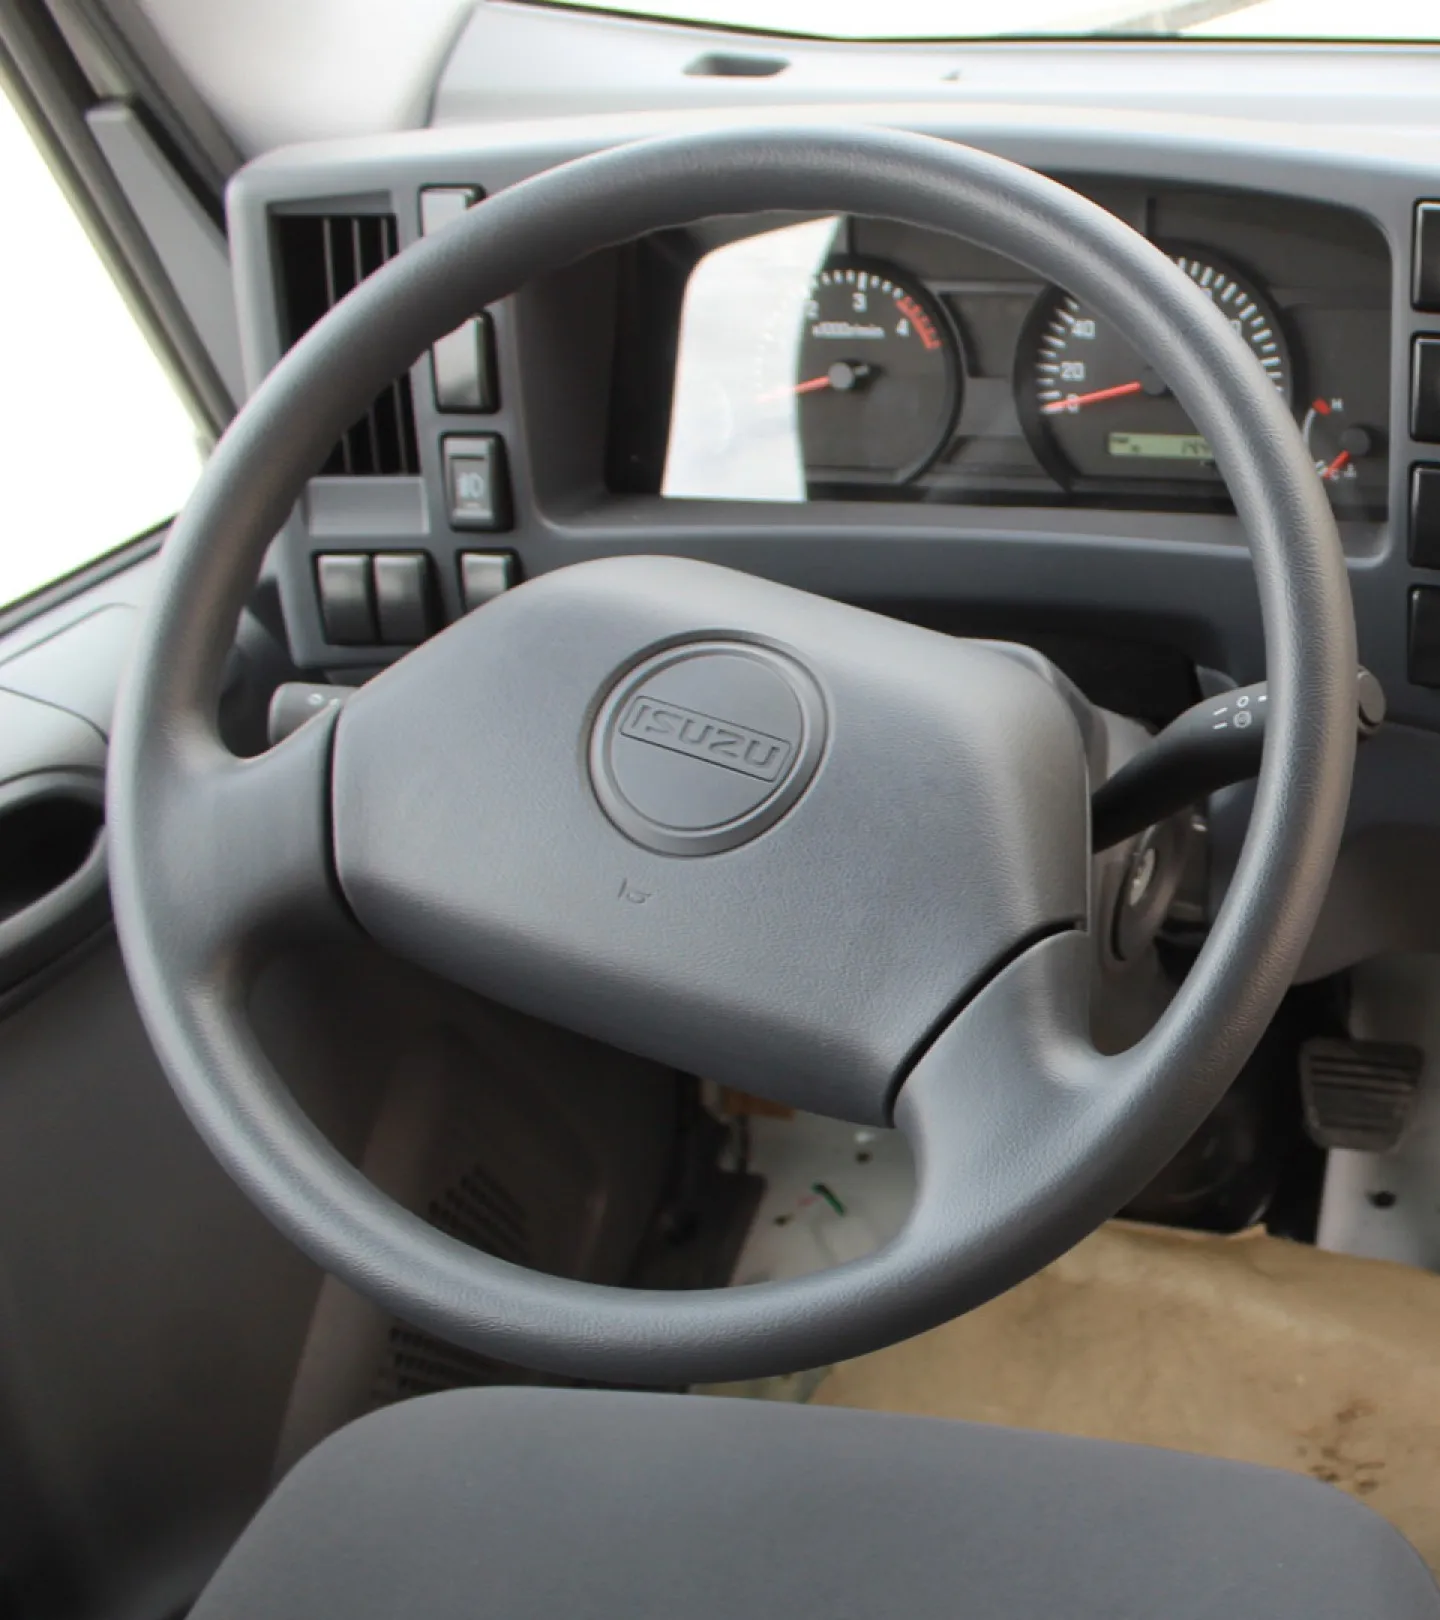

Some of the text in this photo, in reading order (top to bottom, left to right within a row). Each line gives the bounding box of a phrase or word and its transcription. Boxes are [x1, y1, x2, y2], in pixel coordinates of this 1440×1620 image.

[852, 292, 867, 312] 3
[896, 318, 909, 336] 4
[1072, 319, 1096, 340] 40
[1061, 360, 1085, 381] 20
[630, 704, 781, 768] ISUZU
